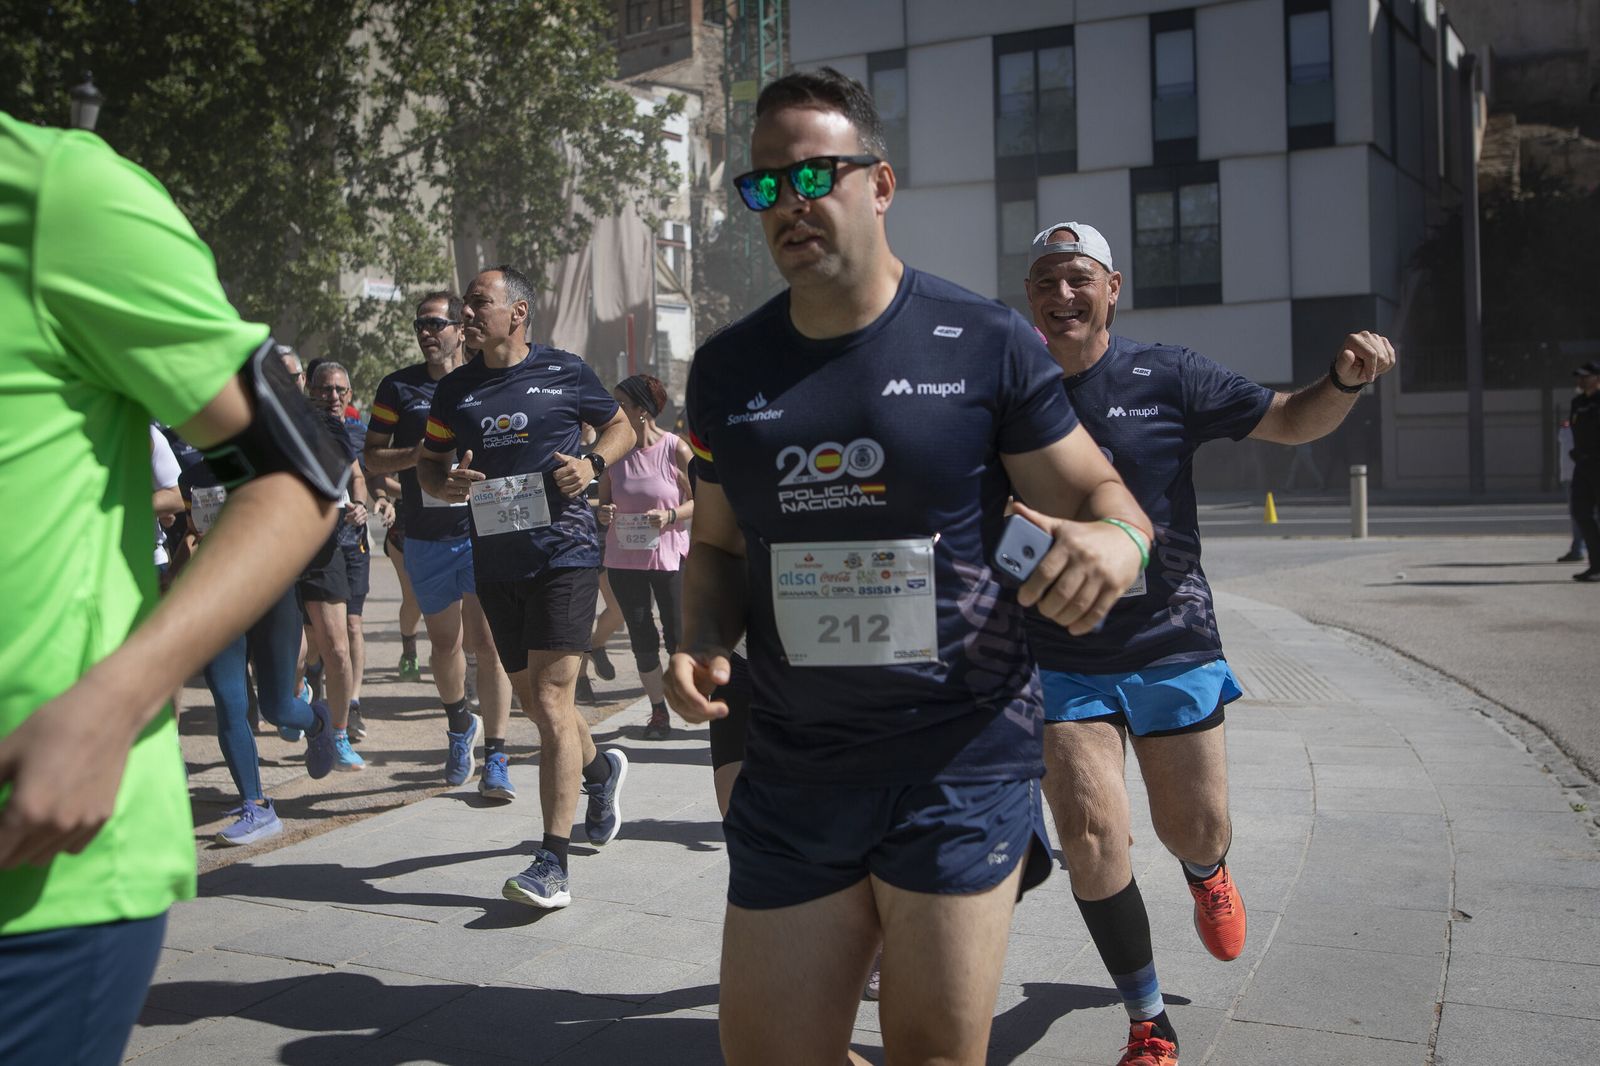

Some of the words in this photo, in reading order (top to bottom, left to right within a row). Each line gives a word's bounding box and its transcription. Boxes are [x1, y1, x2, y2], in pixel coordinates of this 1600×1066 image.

[917, 379, 966, 398] mupol
[727, 409, 784, 426] Santander
[1129, 405, 1159, 418] mupol
[482, 433, 519, 443] POLICIA
[474, 492, 493, 502] alsa
[778, 484, 863, 502] POLICIA
[780, 496, 887, 514] NACIONAL
[779, 571, 816, 586] alsa
[817, 614, 891, 644] 212
